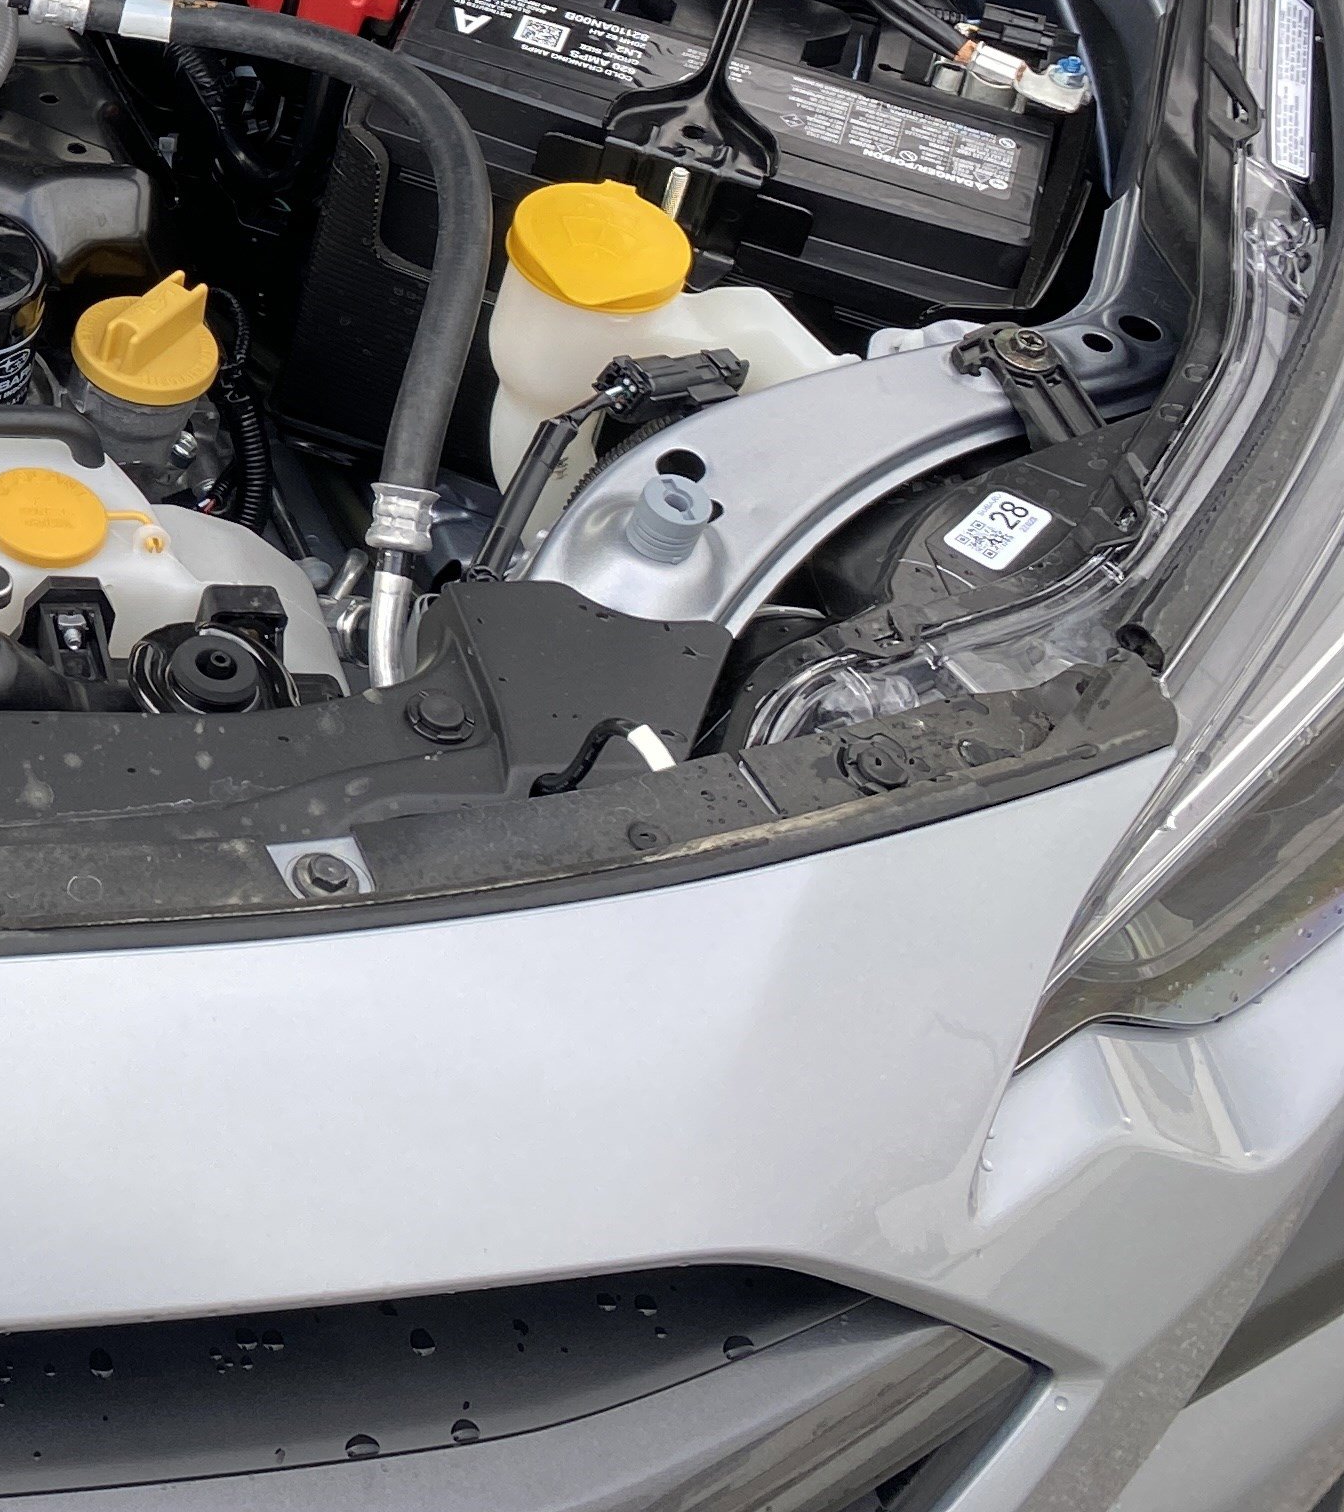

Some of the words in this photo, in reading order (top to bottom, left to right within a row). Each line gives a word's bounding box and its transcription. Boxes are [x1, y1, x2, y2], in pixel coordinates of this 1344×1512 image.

[465, 0, 513, 18] DISTRIBUTED
[453, 5, 492, 34] A
[588, 27, 605, 37] AH
[520, 42, 550, 57] AMPS
[577, 42, 602, 54] SIZE
[618, 36, 646, 49] 20HR
[568, 48, 610, 67] AMPS
[601, 49, 640, 66] GROUP
[614, 44, 643, 58] LN2
[549, 52, 604, 74] CRANKING
[611, 61, 637, 75] 620
[603, 68, 633, 82] COLD
[861, 147, 975, 188] DANGER/POISON
[989, 501, 1029, 530] 28
